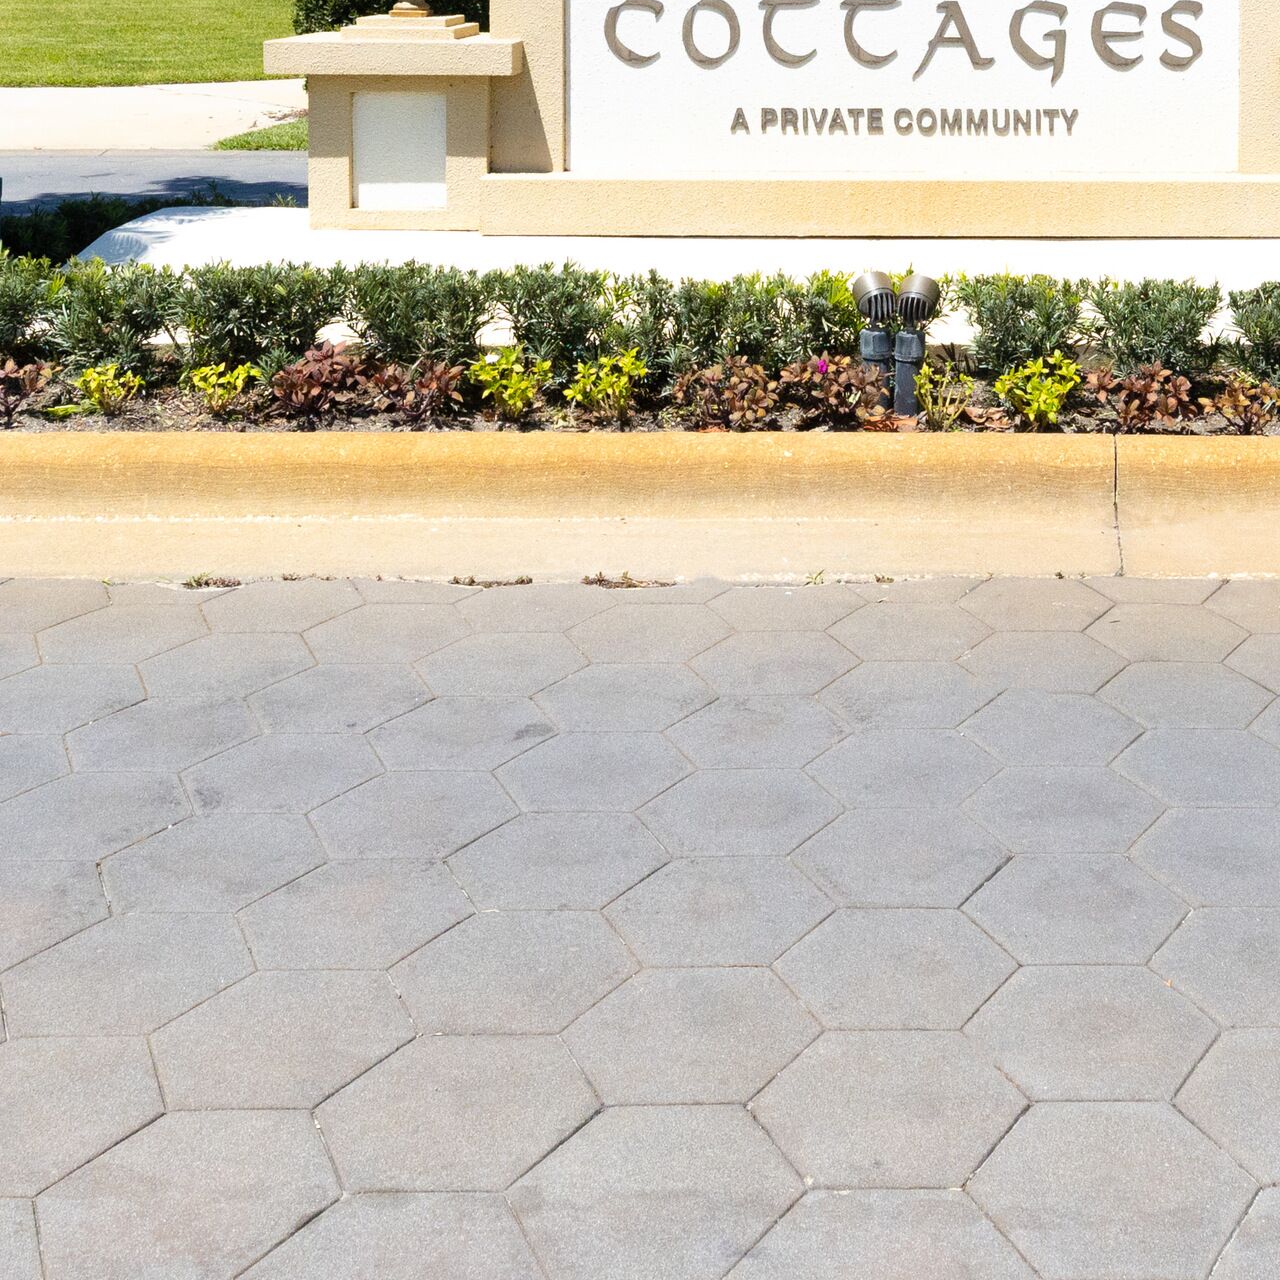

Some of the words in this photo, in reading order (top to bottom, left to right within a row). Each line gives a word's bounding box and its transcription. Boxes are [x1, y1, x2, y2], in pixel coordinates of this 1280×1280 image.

[730, 107, 751, 135] A
[760, 107, 884, 135] PRIVATE
[893, 108, 1079, 137] COMMUNITY
